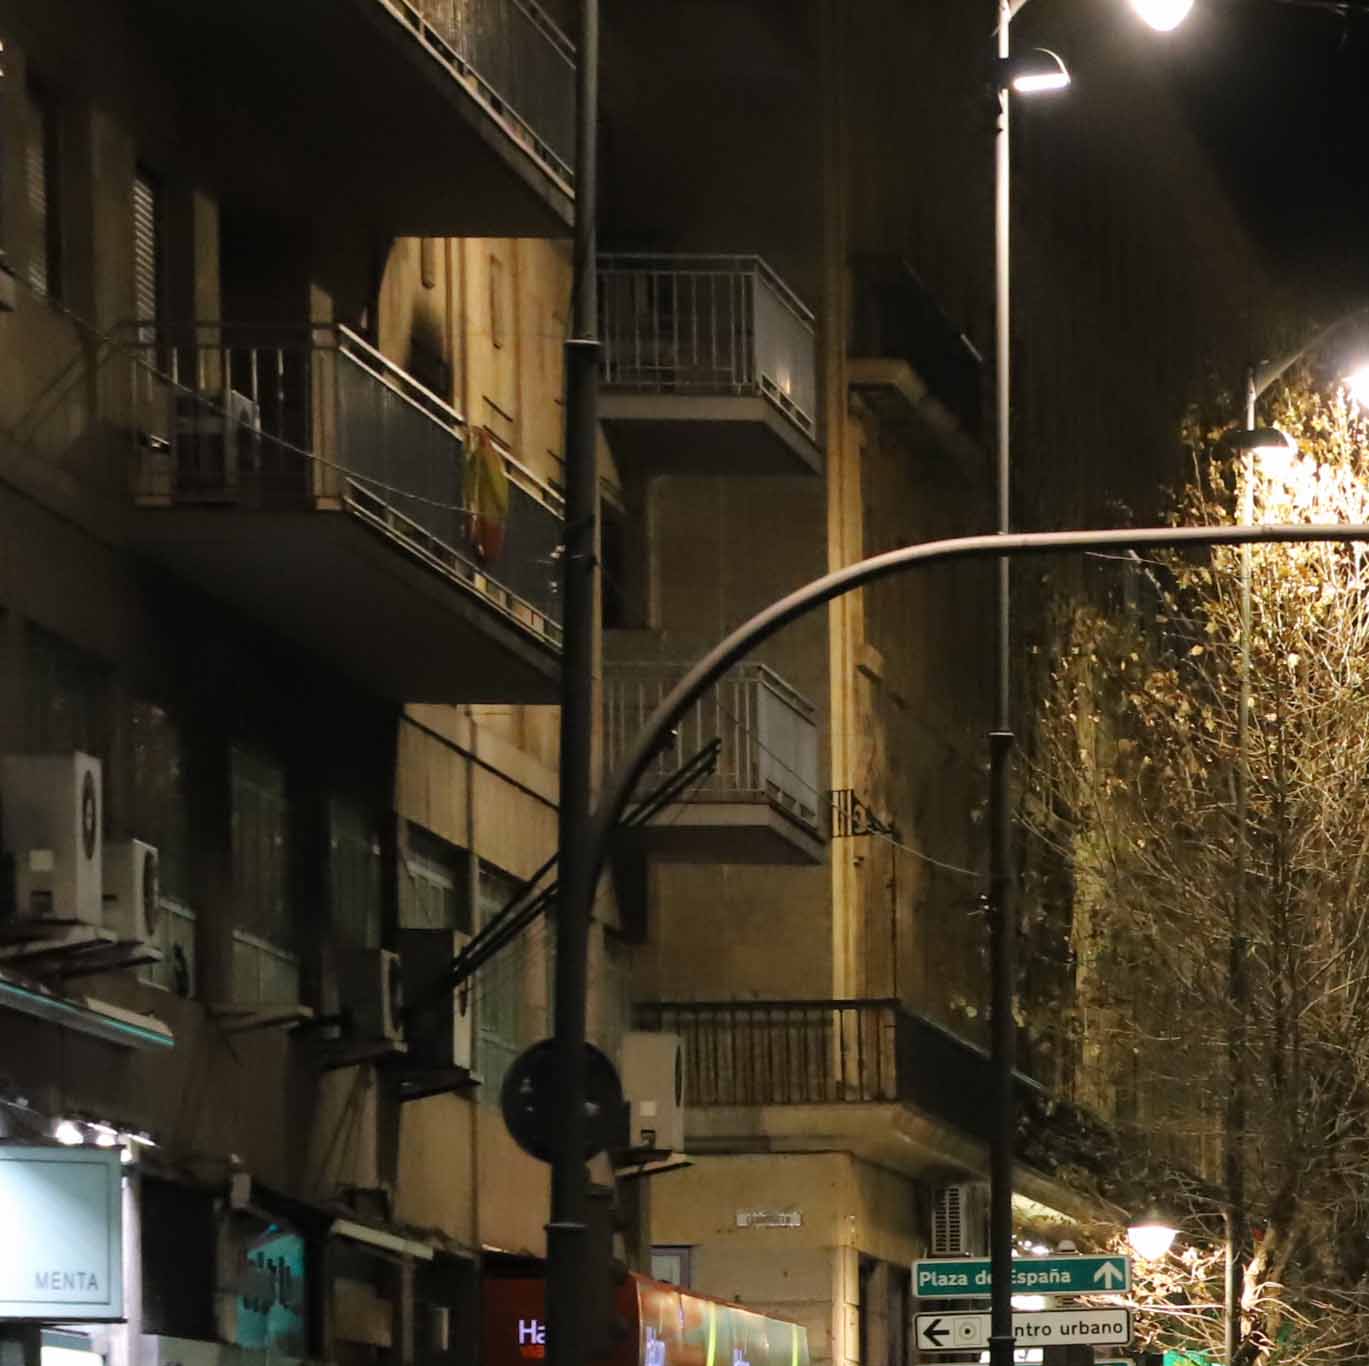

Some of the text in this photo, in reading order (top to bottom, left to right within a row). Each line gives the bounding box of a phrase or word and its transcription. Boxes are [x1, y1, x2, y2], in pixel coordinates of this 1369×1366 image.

[35, 1271, 98, 1290] MENTA
[919, 1270, 968, 1286] Plaza
[1014, 1320, 1123, 1337] ntro urbano
